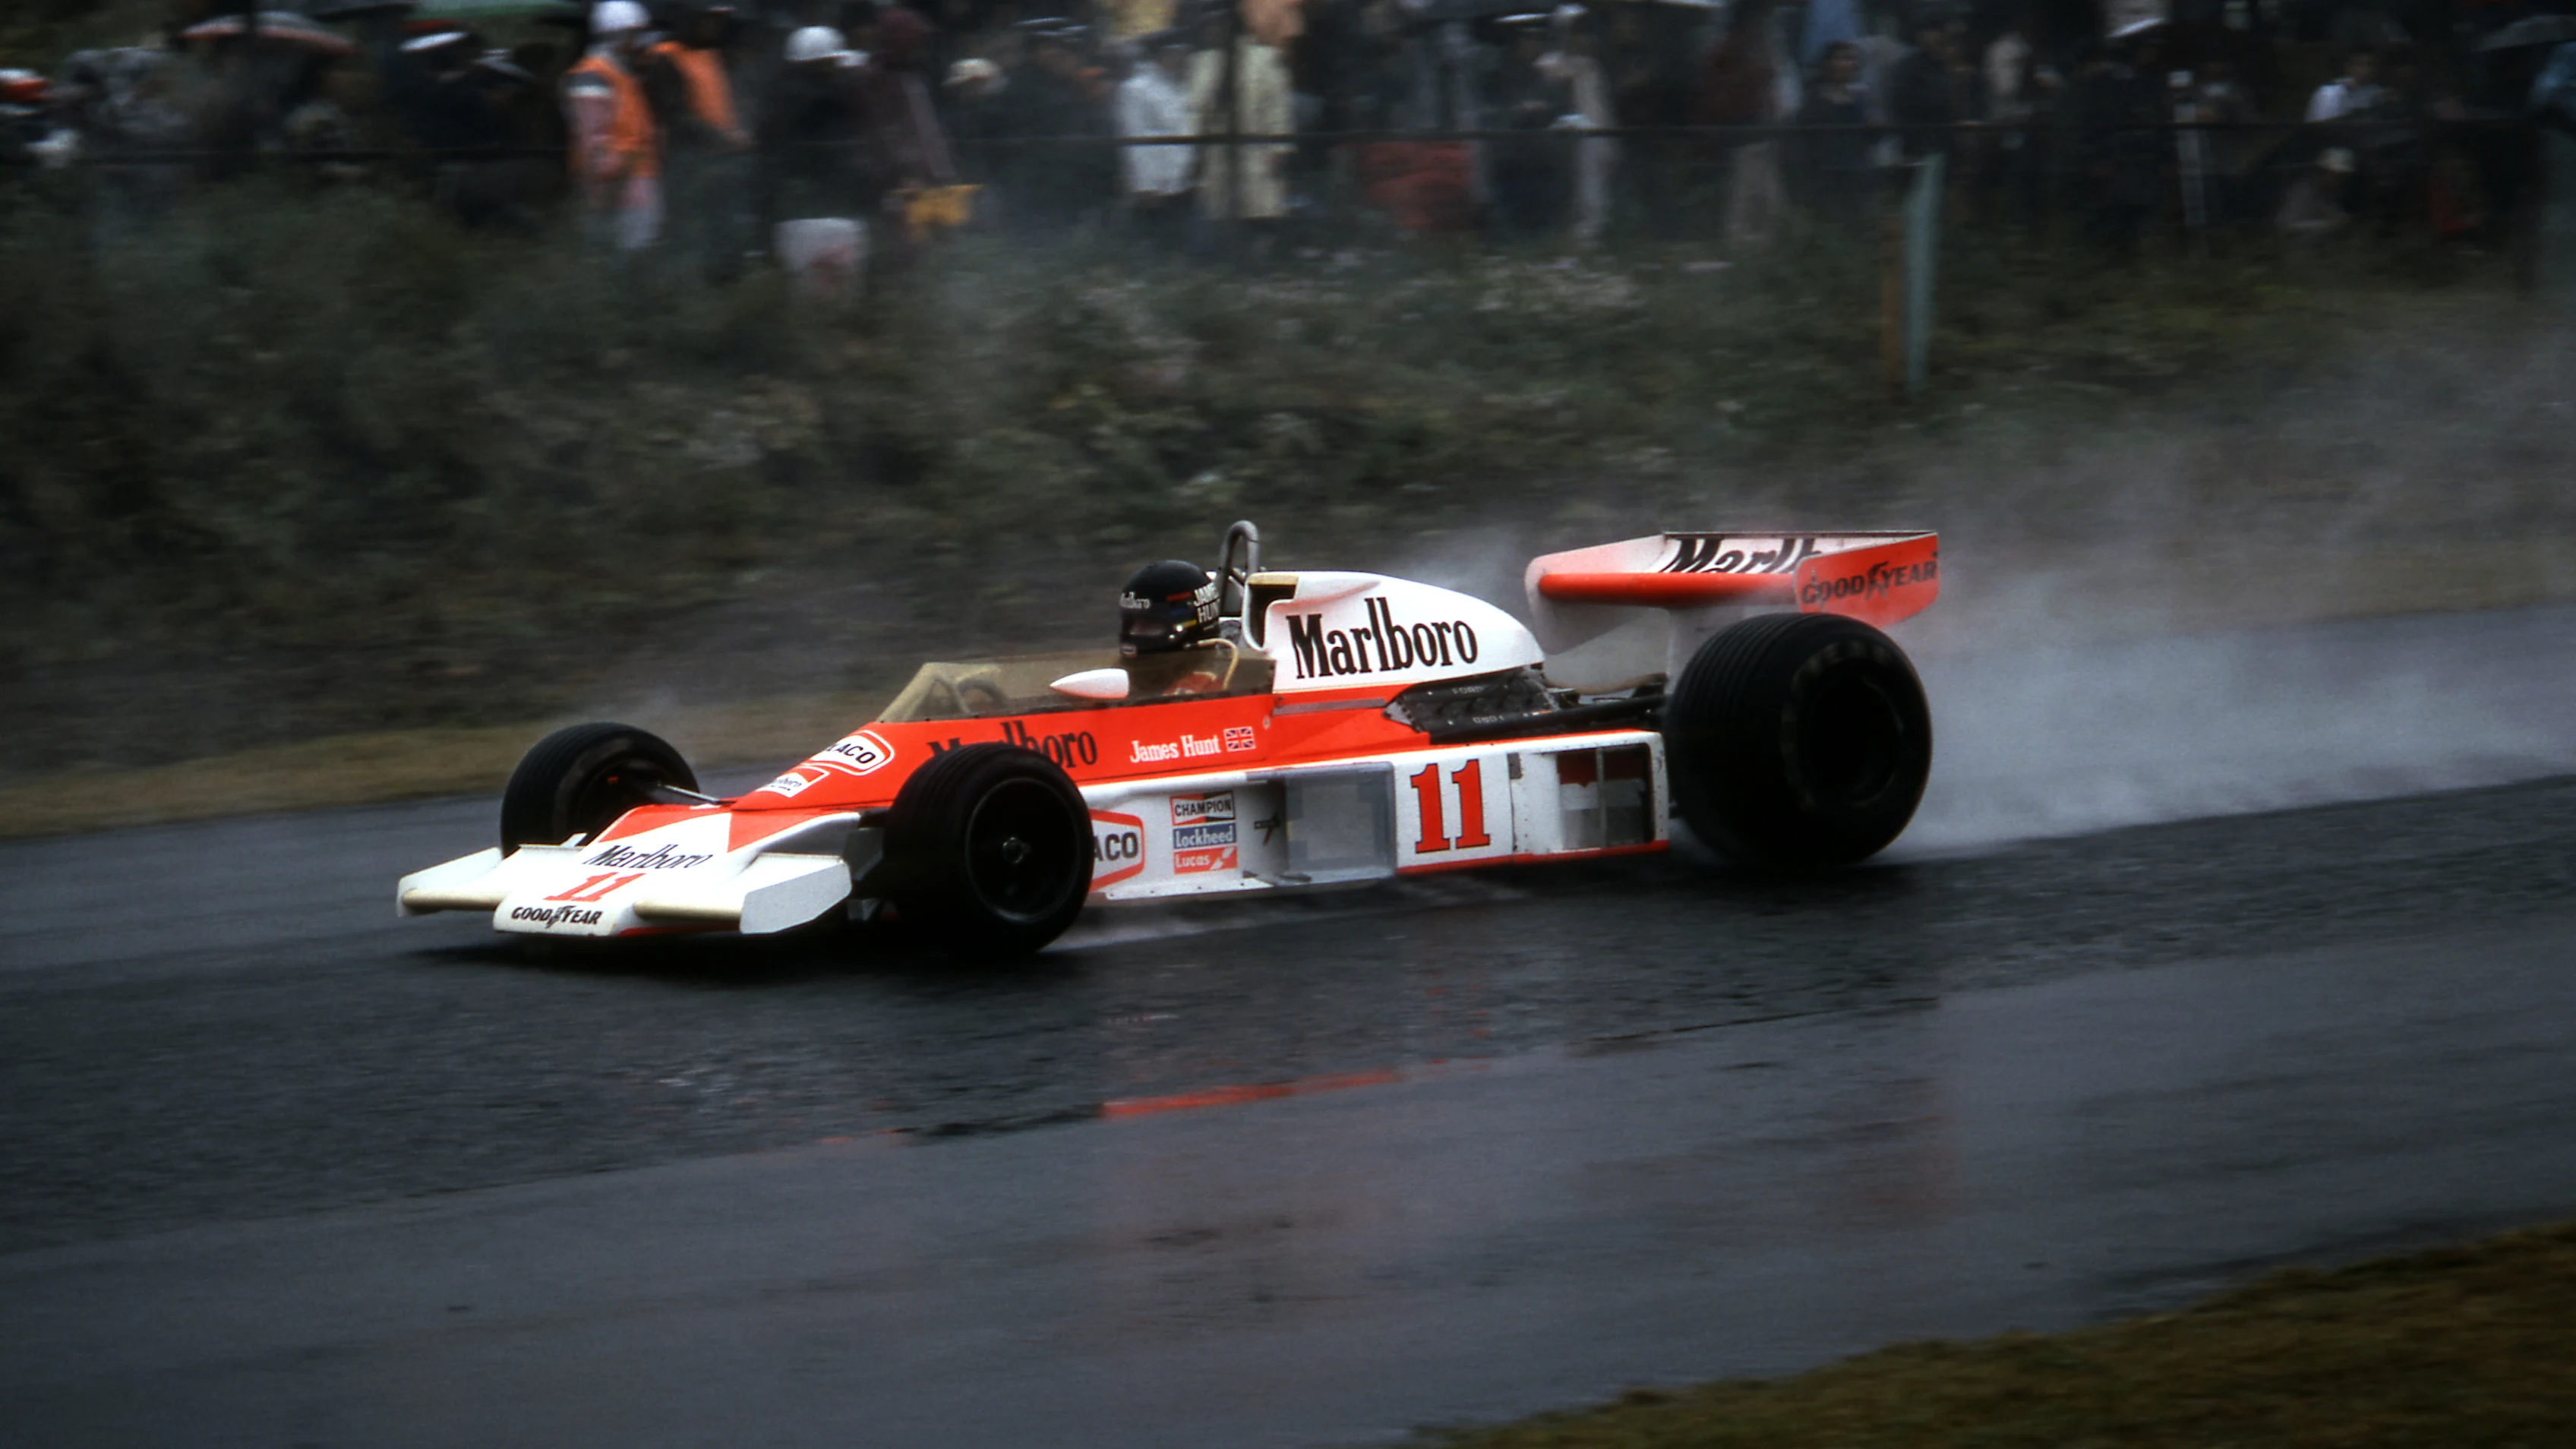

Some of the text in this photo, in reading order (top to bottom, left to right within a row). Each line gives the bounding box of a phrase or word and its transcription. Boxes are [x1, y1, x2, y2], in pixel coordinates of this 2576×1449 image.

[1286, 597, 1478, 679] Marlboro
[1130, 734, 1221, 762] James Hunt
[1175, 800, 1232, 816] CHAMPION
[1410, 759, 1490, 854] 11
[1176, 826, 1233, 848] Lockheed
[582, 844, 713, 869] Marlboro
[1176, 854, 1210, 867] Lucas
[542, 872, 646, 902] 11
[511, 906, 603, 927] GOODYEAR
